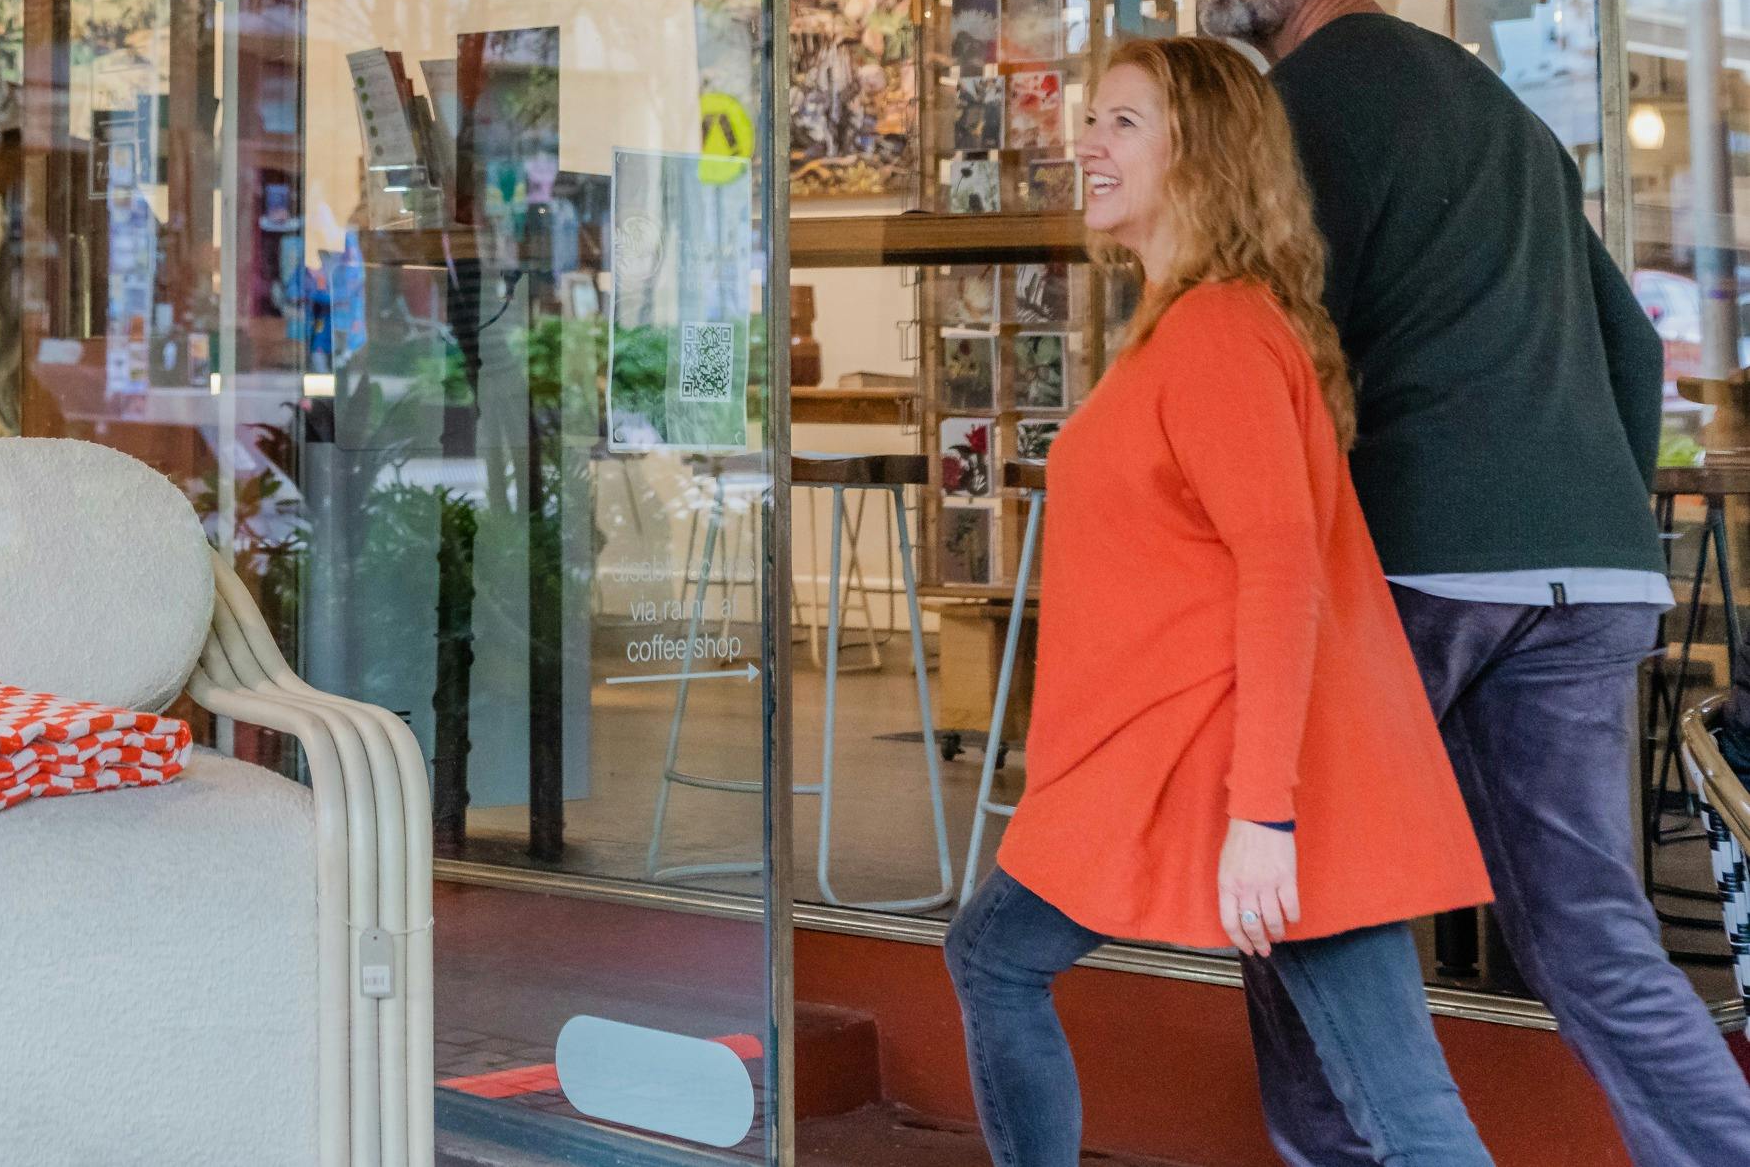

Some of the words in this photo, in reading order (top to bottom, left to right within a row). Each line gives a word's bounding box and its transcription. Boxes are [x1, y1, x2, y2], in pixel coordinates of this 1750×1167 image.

[630, 594, 656, 622] via
[664, 599, 713, 626] ramp
[627, 634, 687, 663] coffee
[694, 633, 741, 664] shop
